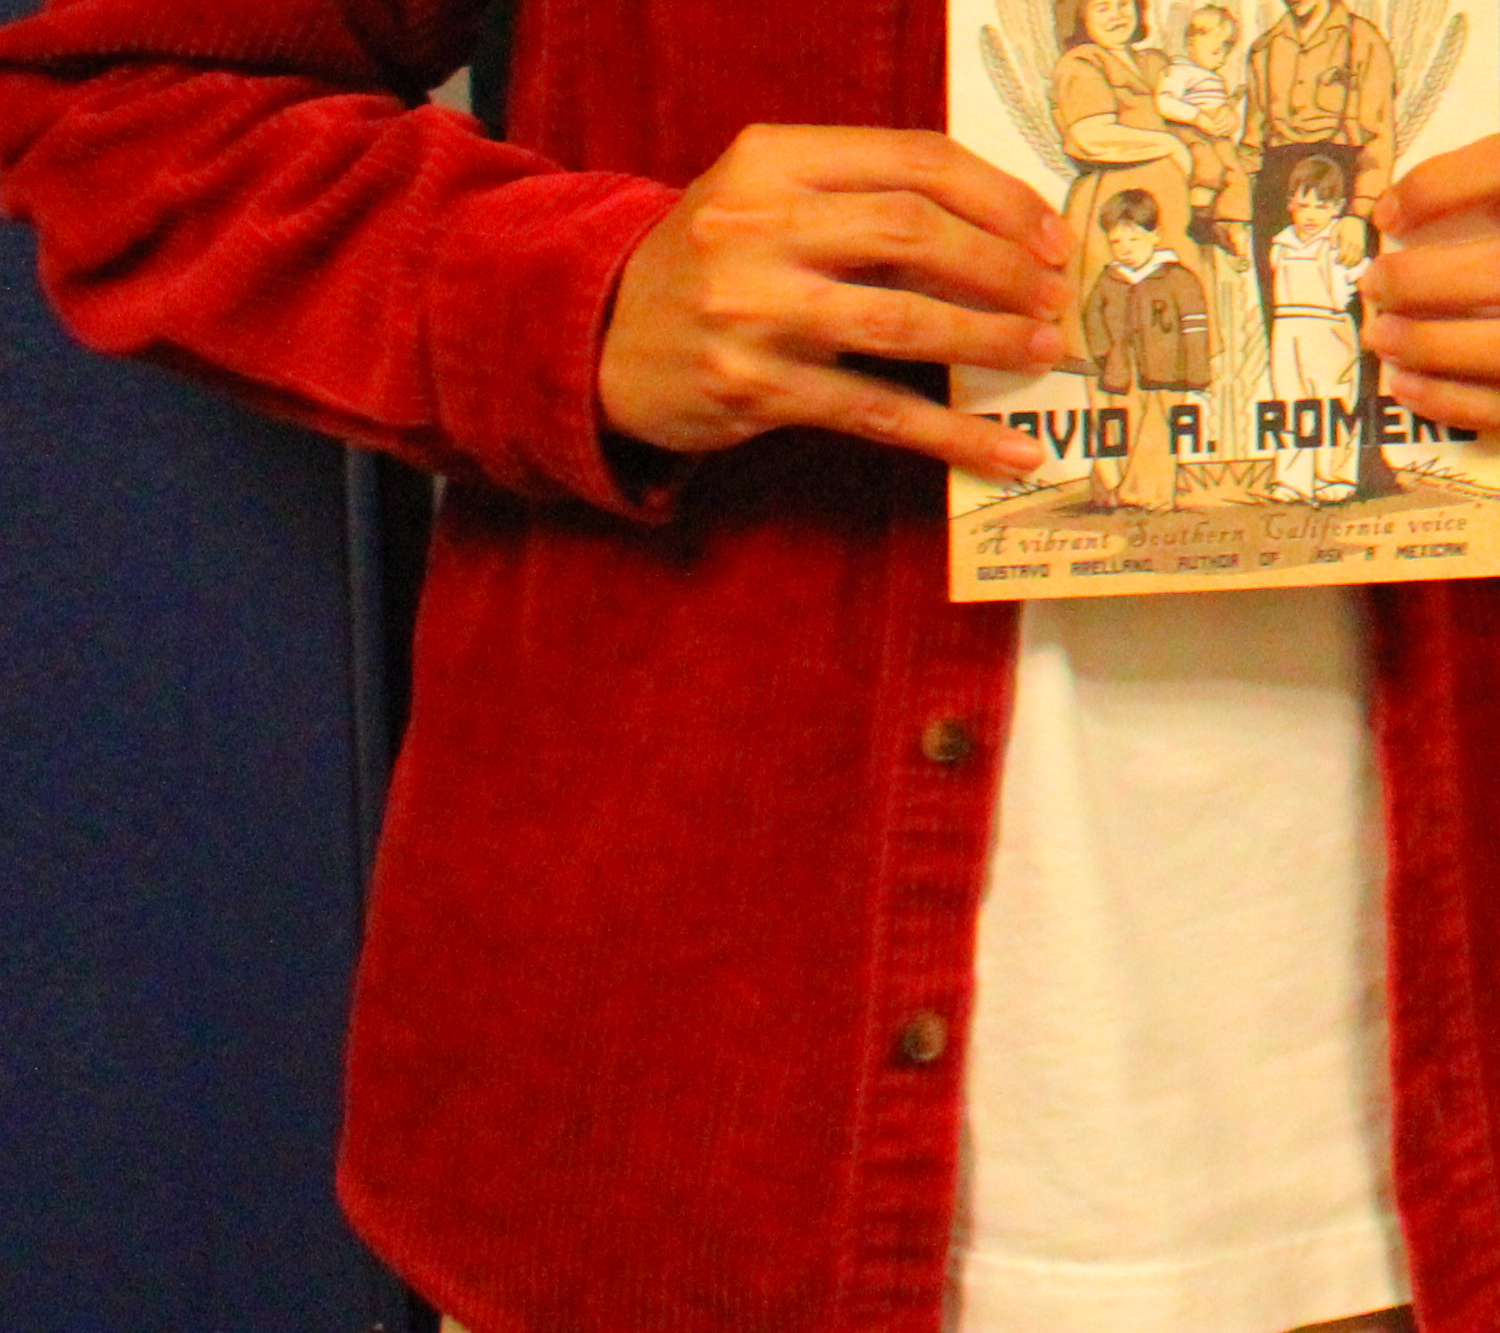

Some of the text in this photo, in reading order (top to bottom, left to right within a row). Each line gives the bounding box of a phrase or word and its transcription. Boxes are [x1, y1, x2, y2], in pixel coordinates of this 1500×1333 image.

[968, 396, 1477, 459] AVID A. ROMER
[1018, 530, 1110, 552] vibrant
